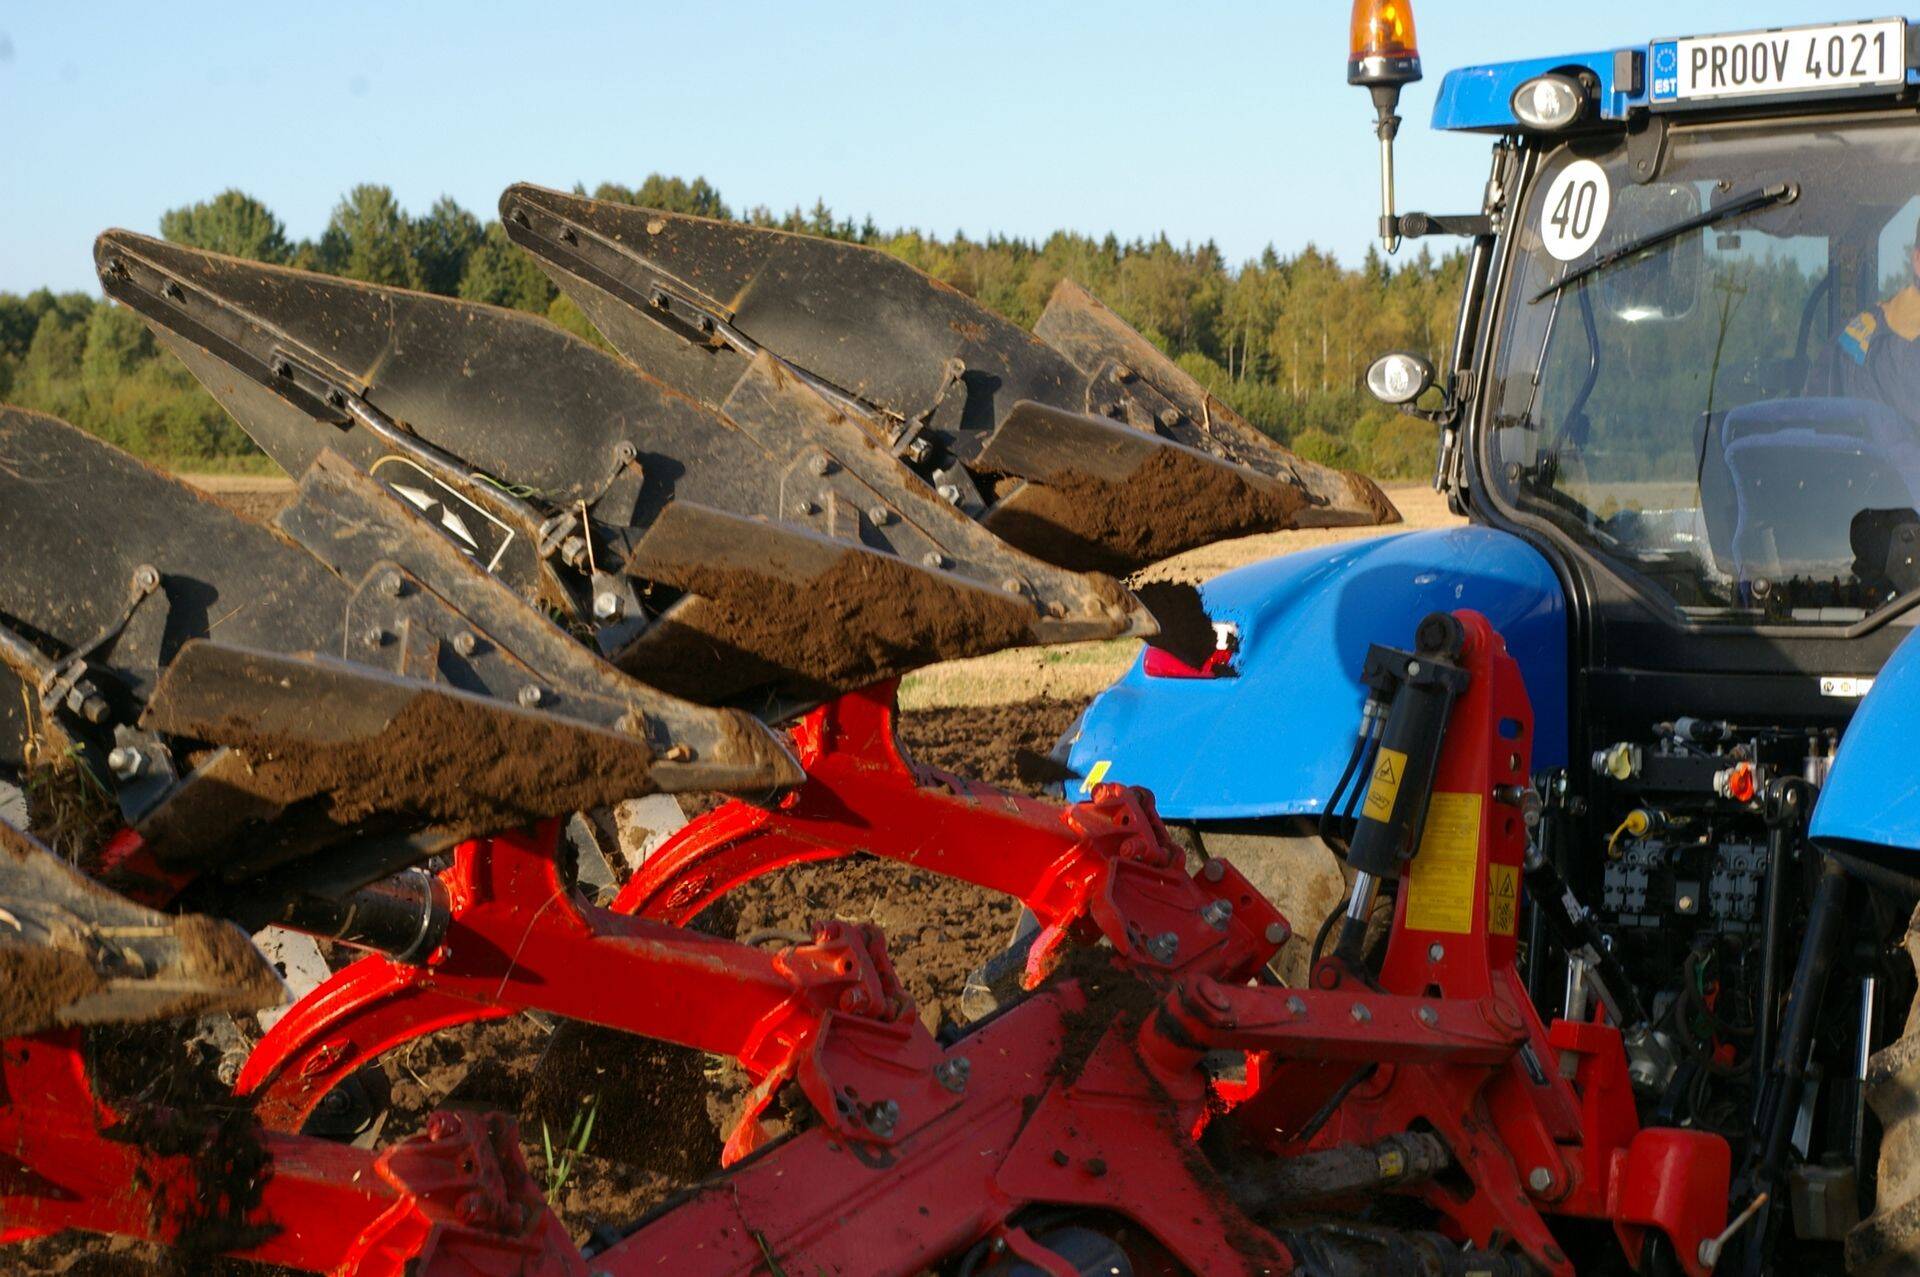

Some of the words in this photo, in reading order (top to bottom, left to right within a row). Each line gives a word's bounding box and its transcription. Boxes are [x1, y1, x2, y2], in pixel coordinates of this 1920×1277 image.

[1654, 78, 1677, 93] EST
[1691, 40, 1789, 89] PROOV
[1805, 31, 1885, 79] 4021
[1551, 180, 1597, 240] 40
